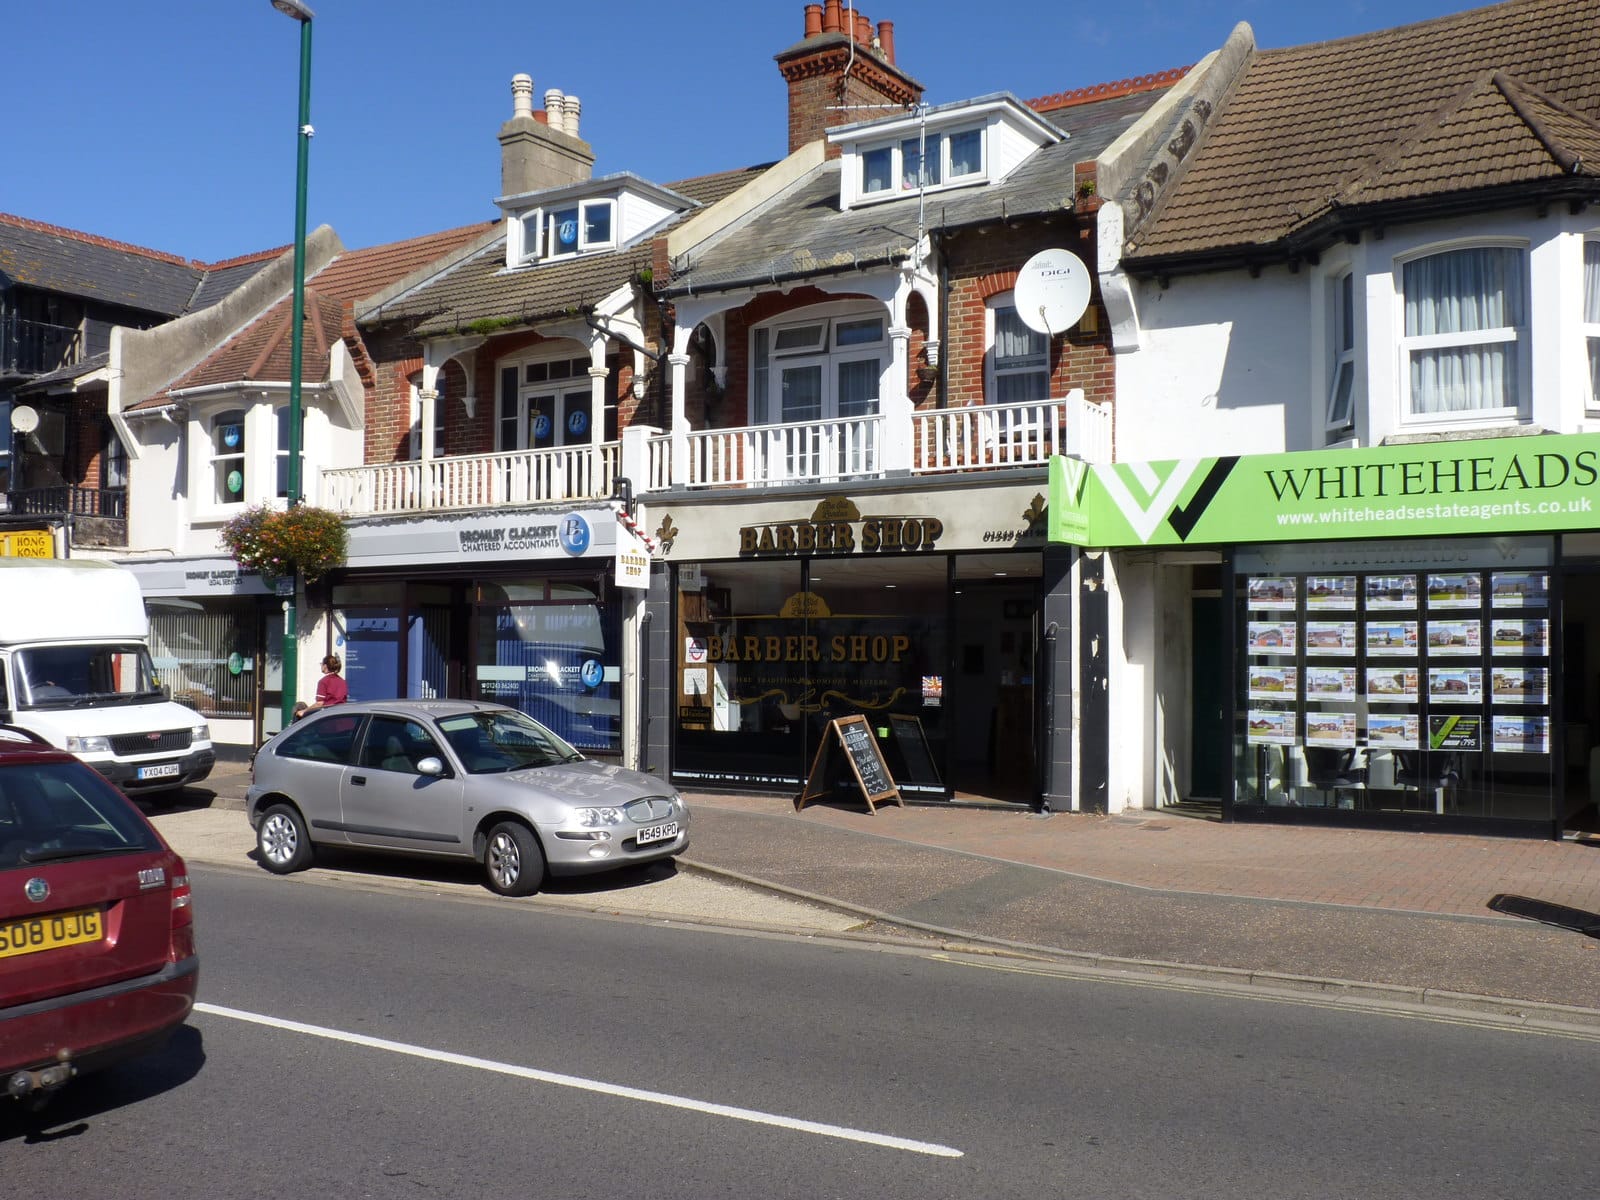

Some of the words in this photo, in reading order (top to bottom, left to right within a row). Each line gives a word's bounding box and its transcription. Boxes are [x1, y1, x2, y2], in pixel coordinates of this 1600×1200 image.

[1264, 449, 1599, 503] WHITEHEADS
[1277, 496, 1592, 526] www.whiteheadsestateagents.co.uk
[17, 537, 45, 546] HONG
[459, 528, 505, 544] BROMLEY
[508, 525, 558, 540] CLACKETT
[462, 542, 501, 552] CHARTERED
[503, 539, 559, 550] ACCOUNTANTS
[739, 522, 856, 555] BARBER
[861, 518, 944, 552] SHOP
[17, 548, 46, 557] KONG
[707, 636, 820, 662] BARBER
[831, 635, 910, 661] SHOP
